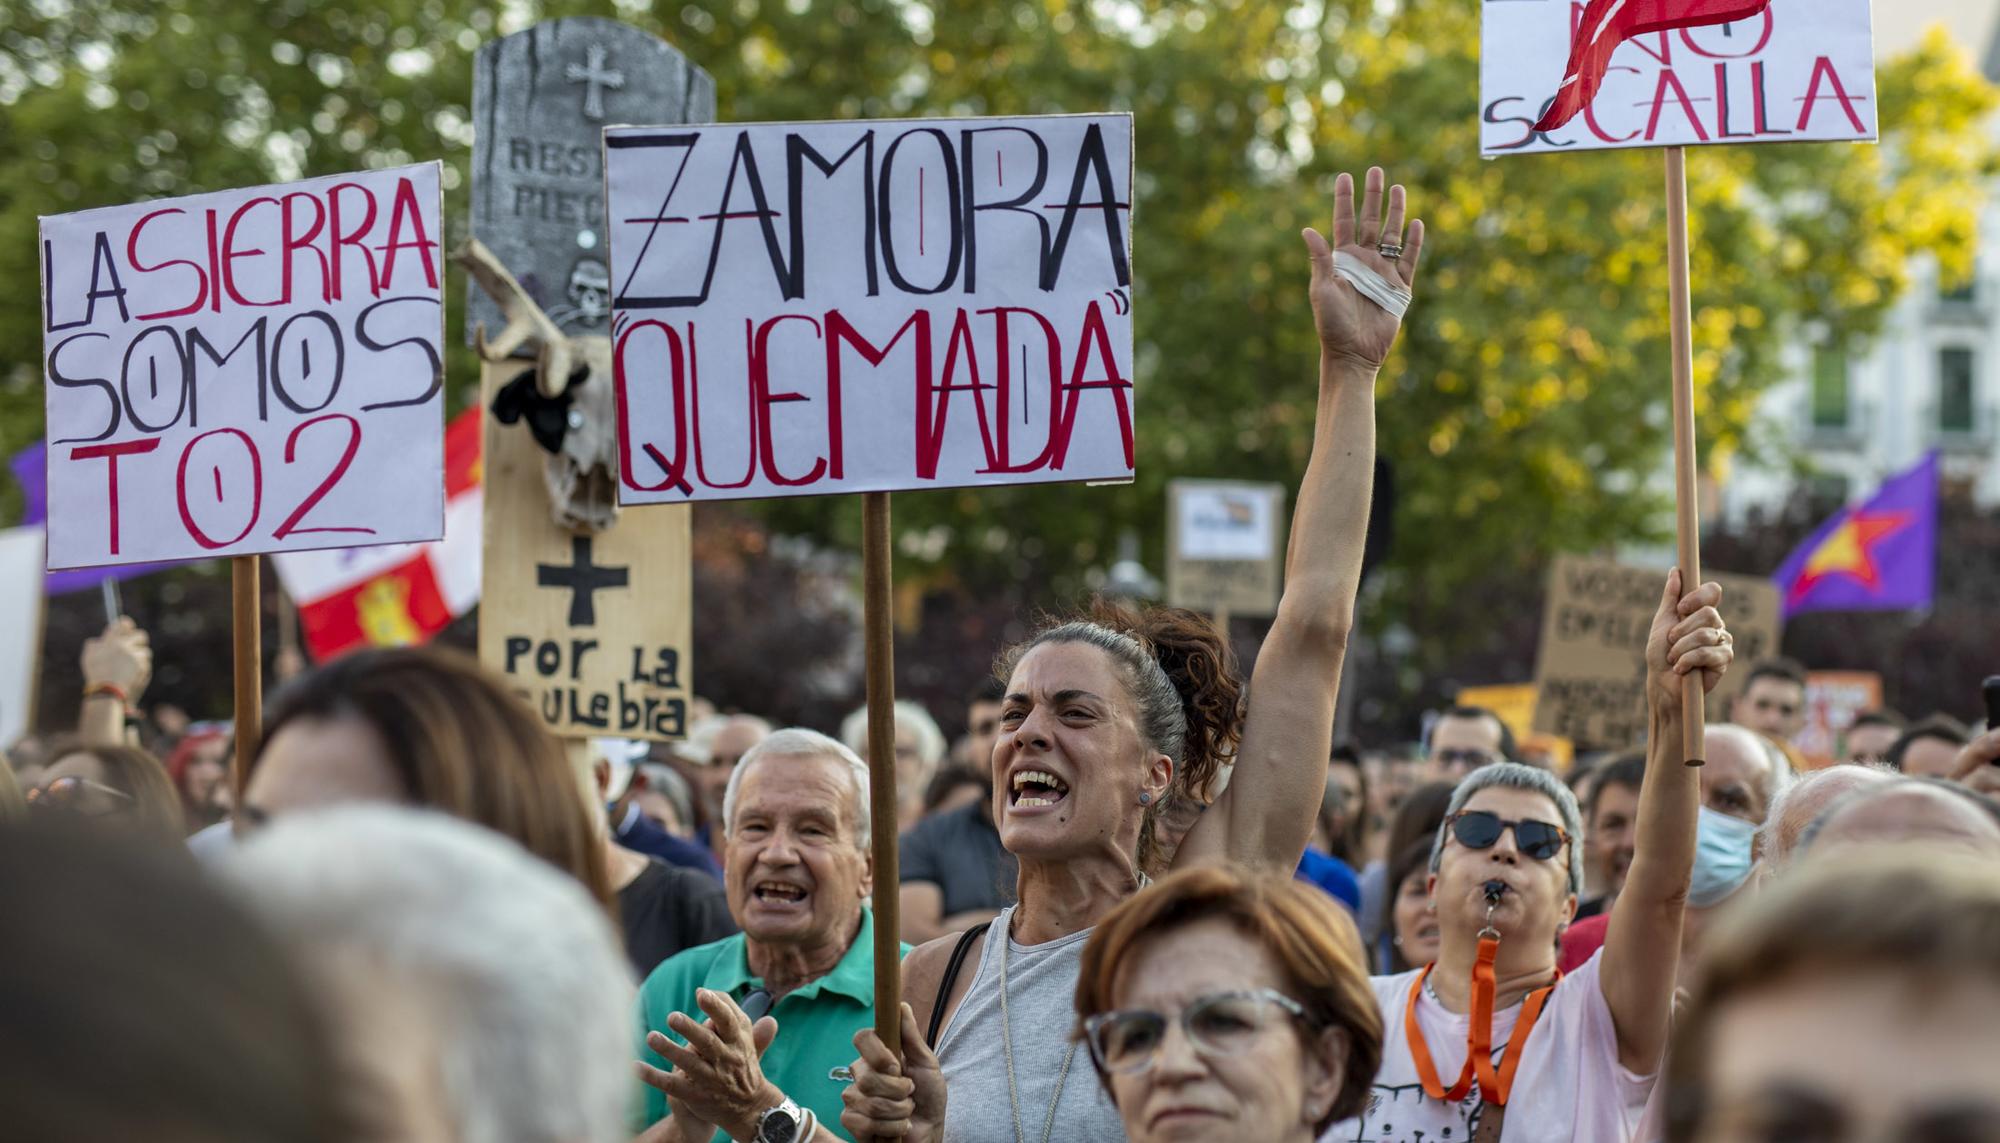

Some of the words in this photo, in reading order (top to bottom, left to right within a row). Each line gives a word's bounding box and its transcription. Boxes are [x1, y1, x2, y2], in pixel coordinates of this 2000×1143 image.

[1583, 56, 1866, 142] CALLA
[44, 231, 129, 333] LA
[127, 177, 440, 321] SIERRA
[606, 123, 1130, 309] ZAMORA
[48, 296, 443, 444] SOMOS
